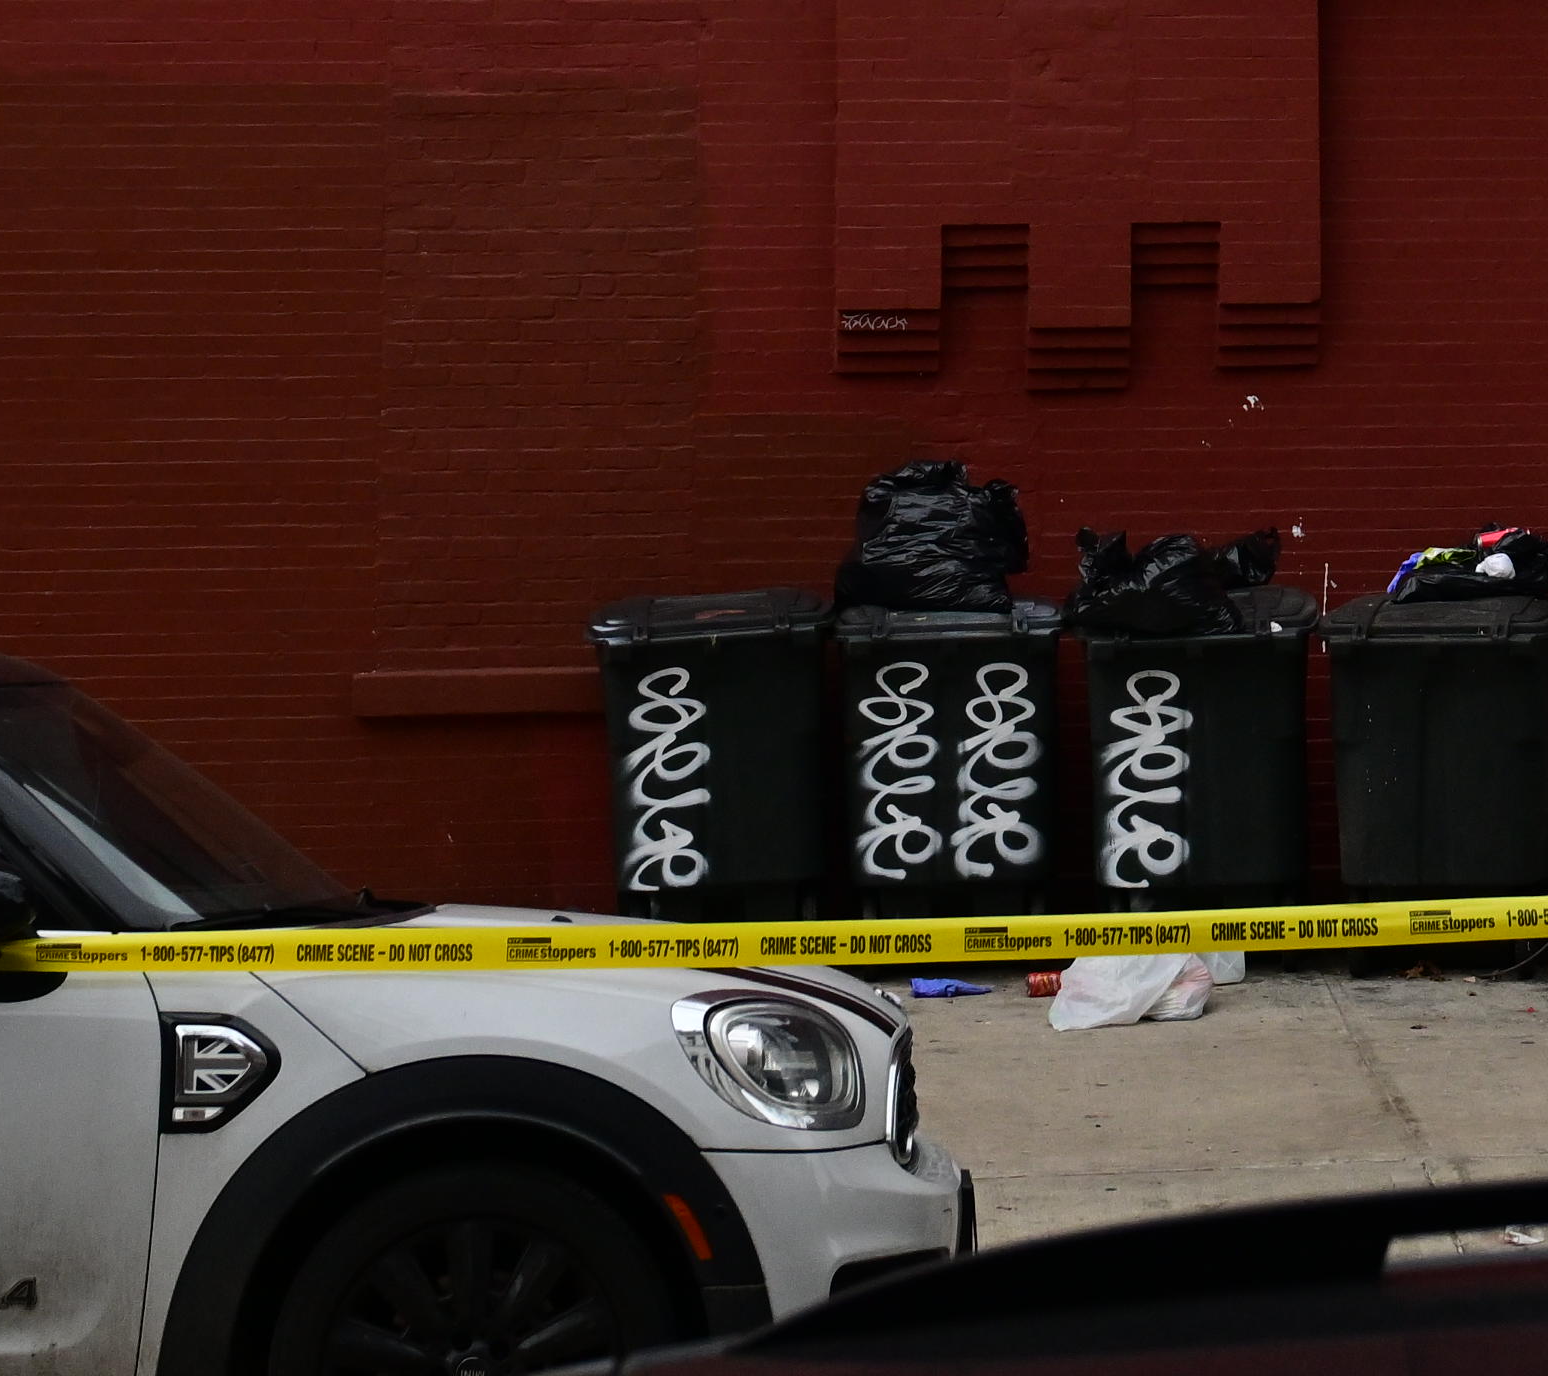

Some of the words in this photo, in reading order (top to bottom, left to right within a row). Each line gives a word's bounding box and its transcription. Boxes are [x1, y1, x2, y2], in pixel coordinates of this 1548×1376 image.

[1063, 925, 1153, 947] 1-800-577-TIPS
[1154, 922, 1191, 947] (8477)
[1210, 921, 1247, 942] CRIME
[1249, 919, 1285, 940] SCENE
[1297, 919, 1314, 939] DO
[1316, 918, 1339, 938] NOT
[1341, 916, 1378, 937] CROSS
[139, 944, 234, 962] 1-800-577-TIPS
[236, 942, 274, 964] (8477)
[295, 943, 334, 962] CRIME
[336, 943, 375, 962] SCENE
[388, 943, 405, 962] DO
[408, 943, 432, 962] NOT
[433, 942, 473, 962] CROSS
[608, 938, 700, 958] 1-800-577-TIPS
[702, 936, 739, 959] (8477)
[759, 935, 797, 955] CRIME
[799, 935, 836, 955] SCENE
[849, 934, 866, 954] DO
[868, 934, 892, 954] NOT
[893, 932, 932, 954] CROSS
